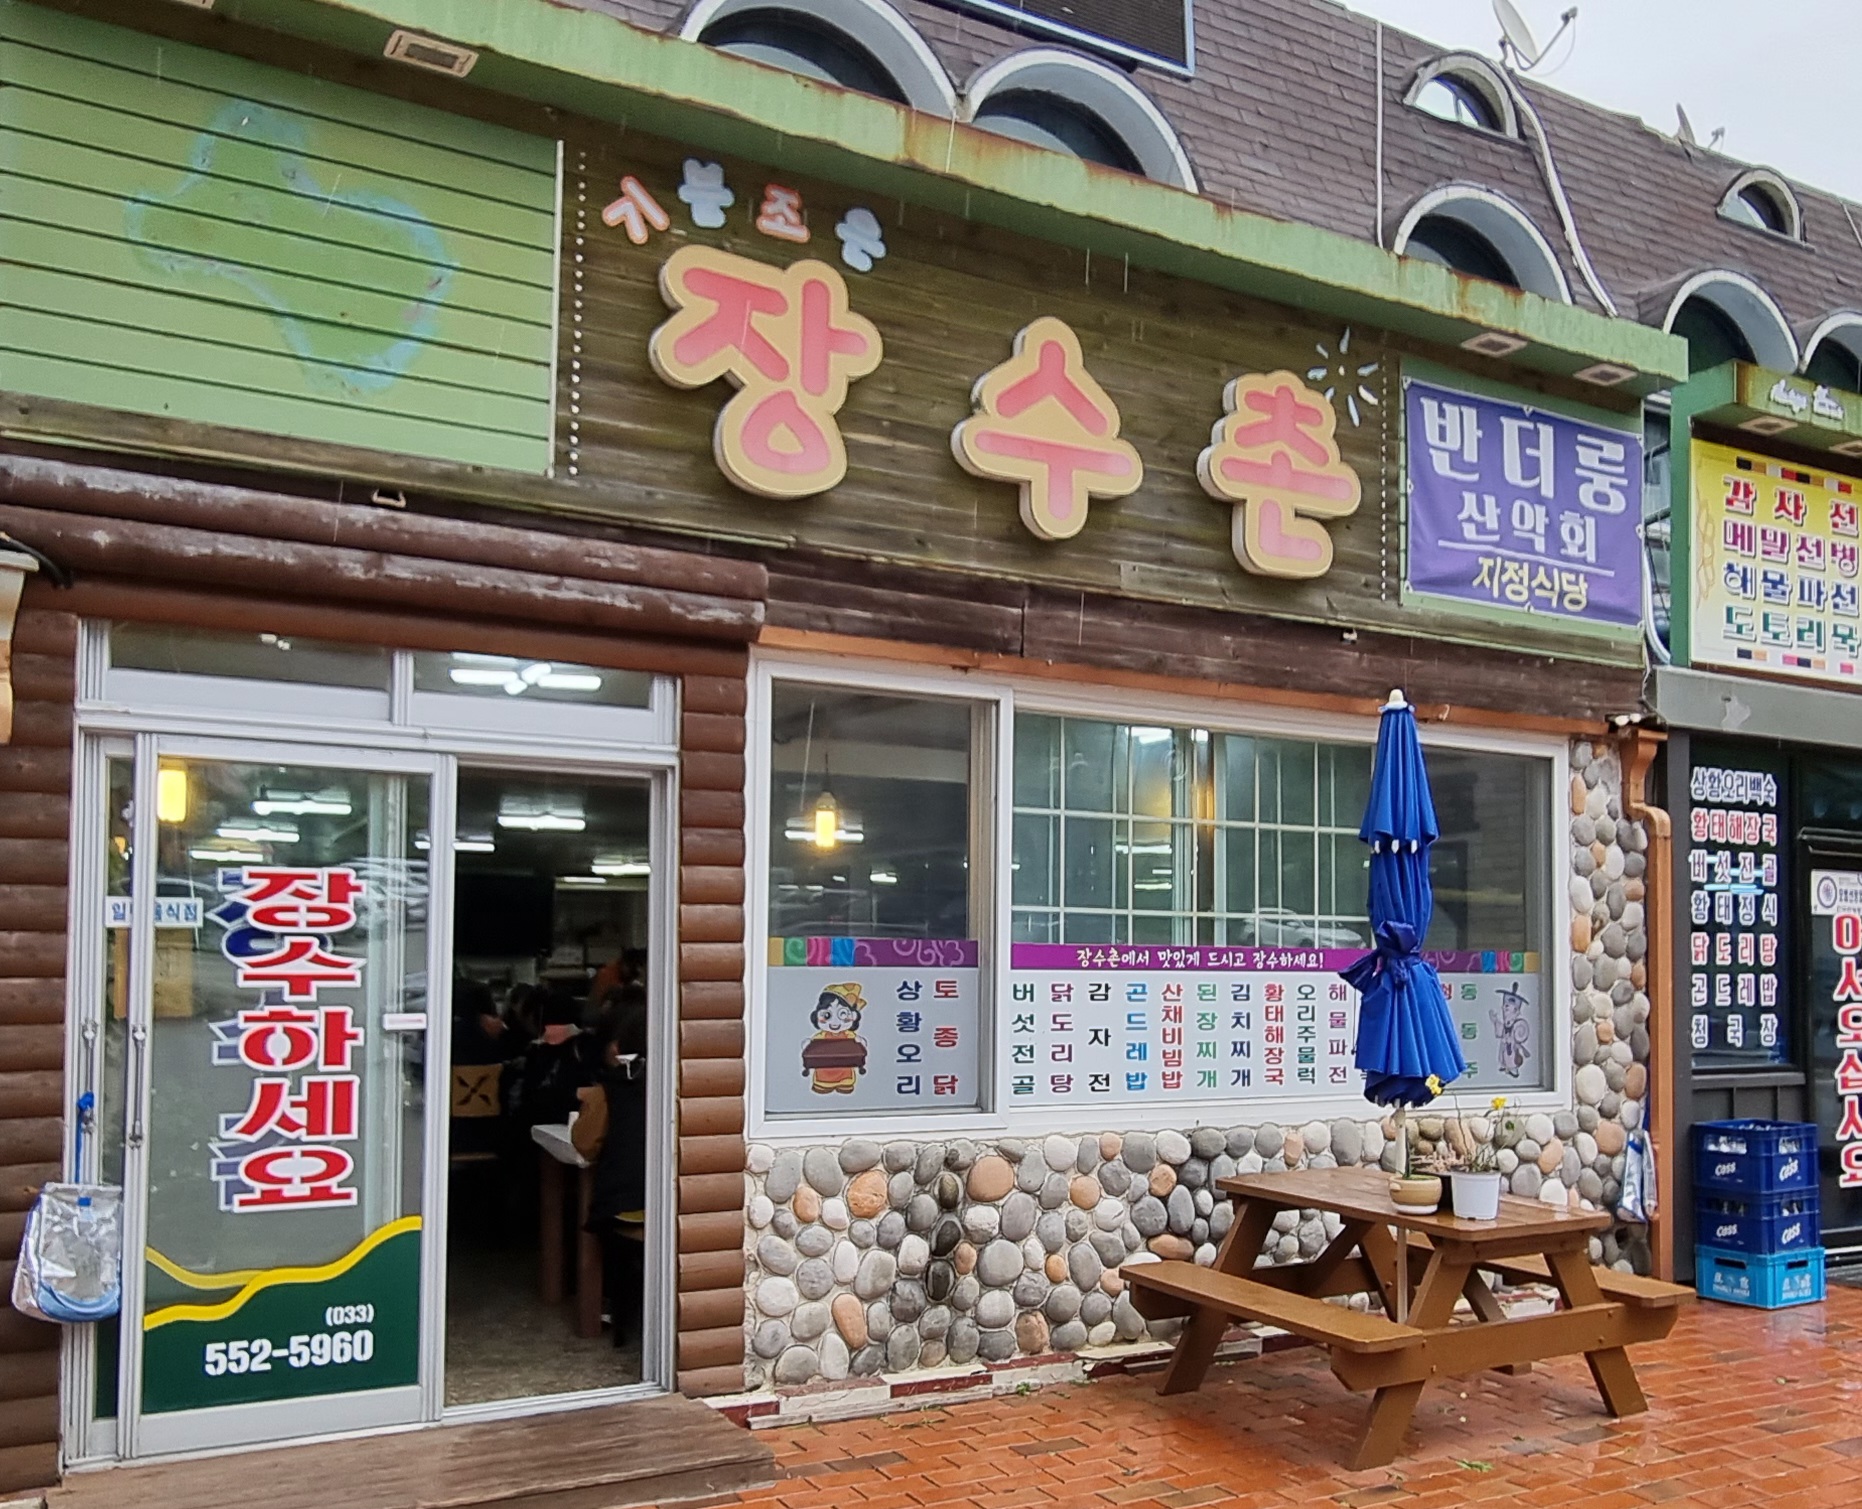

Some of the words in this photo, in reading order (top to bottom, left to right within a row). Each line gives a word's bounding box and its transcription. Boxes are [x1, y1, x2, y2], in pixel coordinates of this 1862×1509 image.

[652, 246, 1360, 576] 장수촌
[1420, 397, 1628, 514] 반더룽
[1457, 491, 1596, 563] 산악회
[1472, 556, 1588, 611] 지정식당
[1723, 561, 1859, 616] 해물파전
[1723, 605, 1860, 657] 도토리묵
[1691, 767, 1777, 806] 상황오리백숙
[1691, 808, 1777, 846] 황태해장국
[1691, 850, 1777, 886] 버섯전골
[1691, 890, 1777, 926] 황태정식
[1077, 948, 1149, 967] 장수촌에서
[1158, 949, 1199, 968] 맛있게
[1207, 950, 1246, 967] 드시고
[1253, 950, 1323, 969] 장수하세요!
[1691, 932, 1777, 966] 닭도리탕
[1692, 973, 1777, 1007] 곤드레밥
[233, 866, 367, 1213] 장수하세요
[896, 980, 922, 1095] 상황오리
[933, 979, 959, 1096] 토종닭
[1011, 983, 1035, 1095] 버섯전골
[1050, 983, 1074, 1094] 닭도리탕
[1088, 983, 1111, 1092] 감자전
[1125, 983, 1148, 1091] 곤드레밥
[1161, 983, 1183, 1090] 산채비빔밥
[1196, 983, 1218, 1088] 된장찌개
[1230, 983, 1250, 1087] 김치찌개
[1264, 983, 1285, 1086] 황태해장국
[1296, 983, 1317, 1085] 오리주물럭
[1328, 983, 1347, 1084] 해물파전
[1692, 1014, 1778, 1048] 청국장
[1714, 1162, 1736, 1177] Cass
[1716, 1224, 1738, 1237] Cass
[325, 1303, 375, 1326] (033)
[205, 1329, 374, 1376] 552-5960
